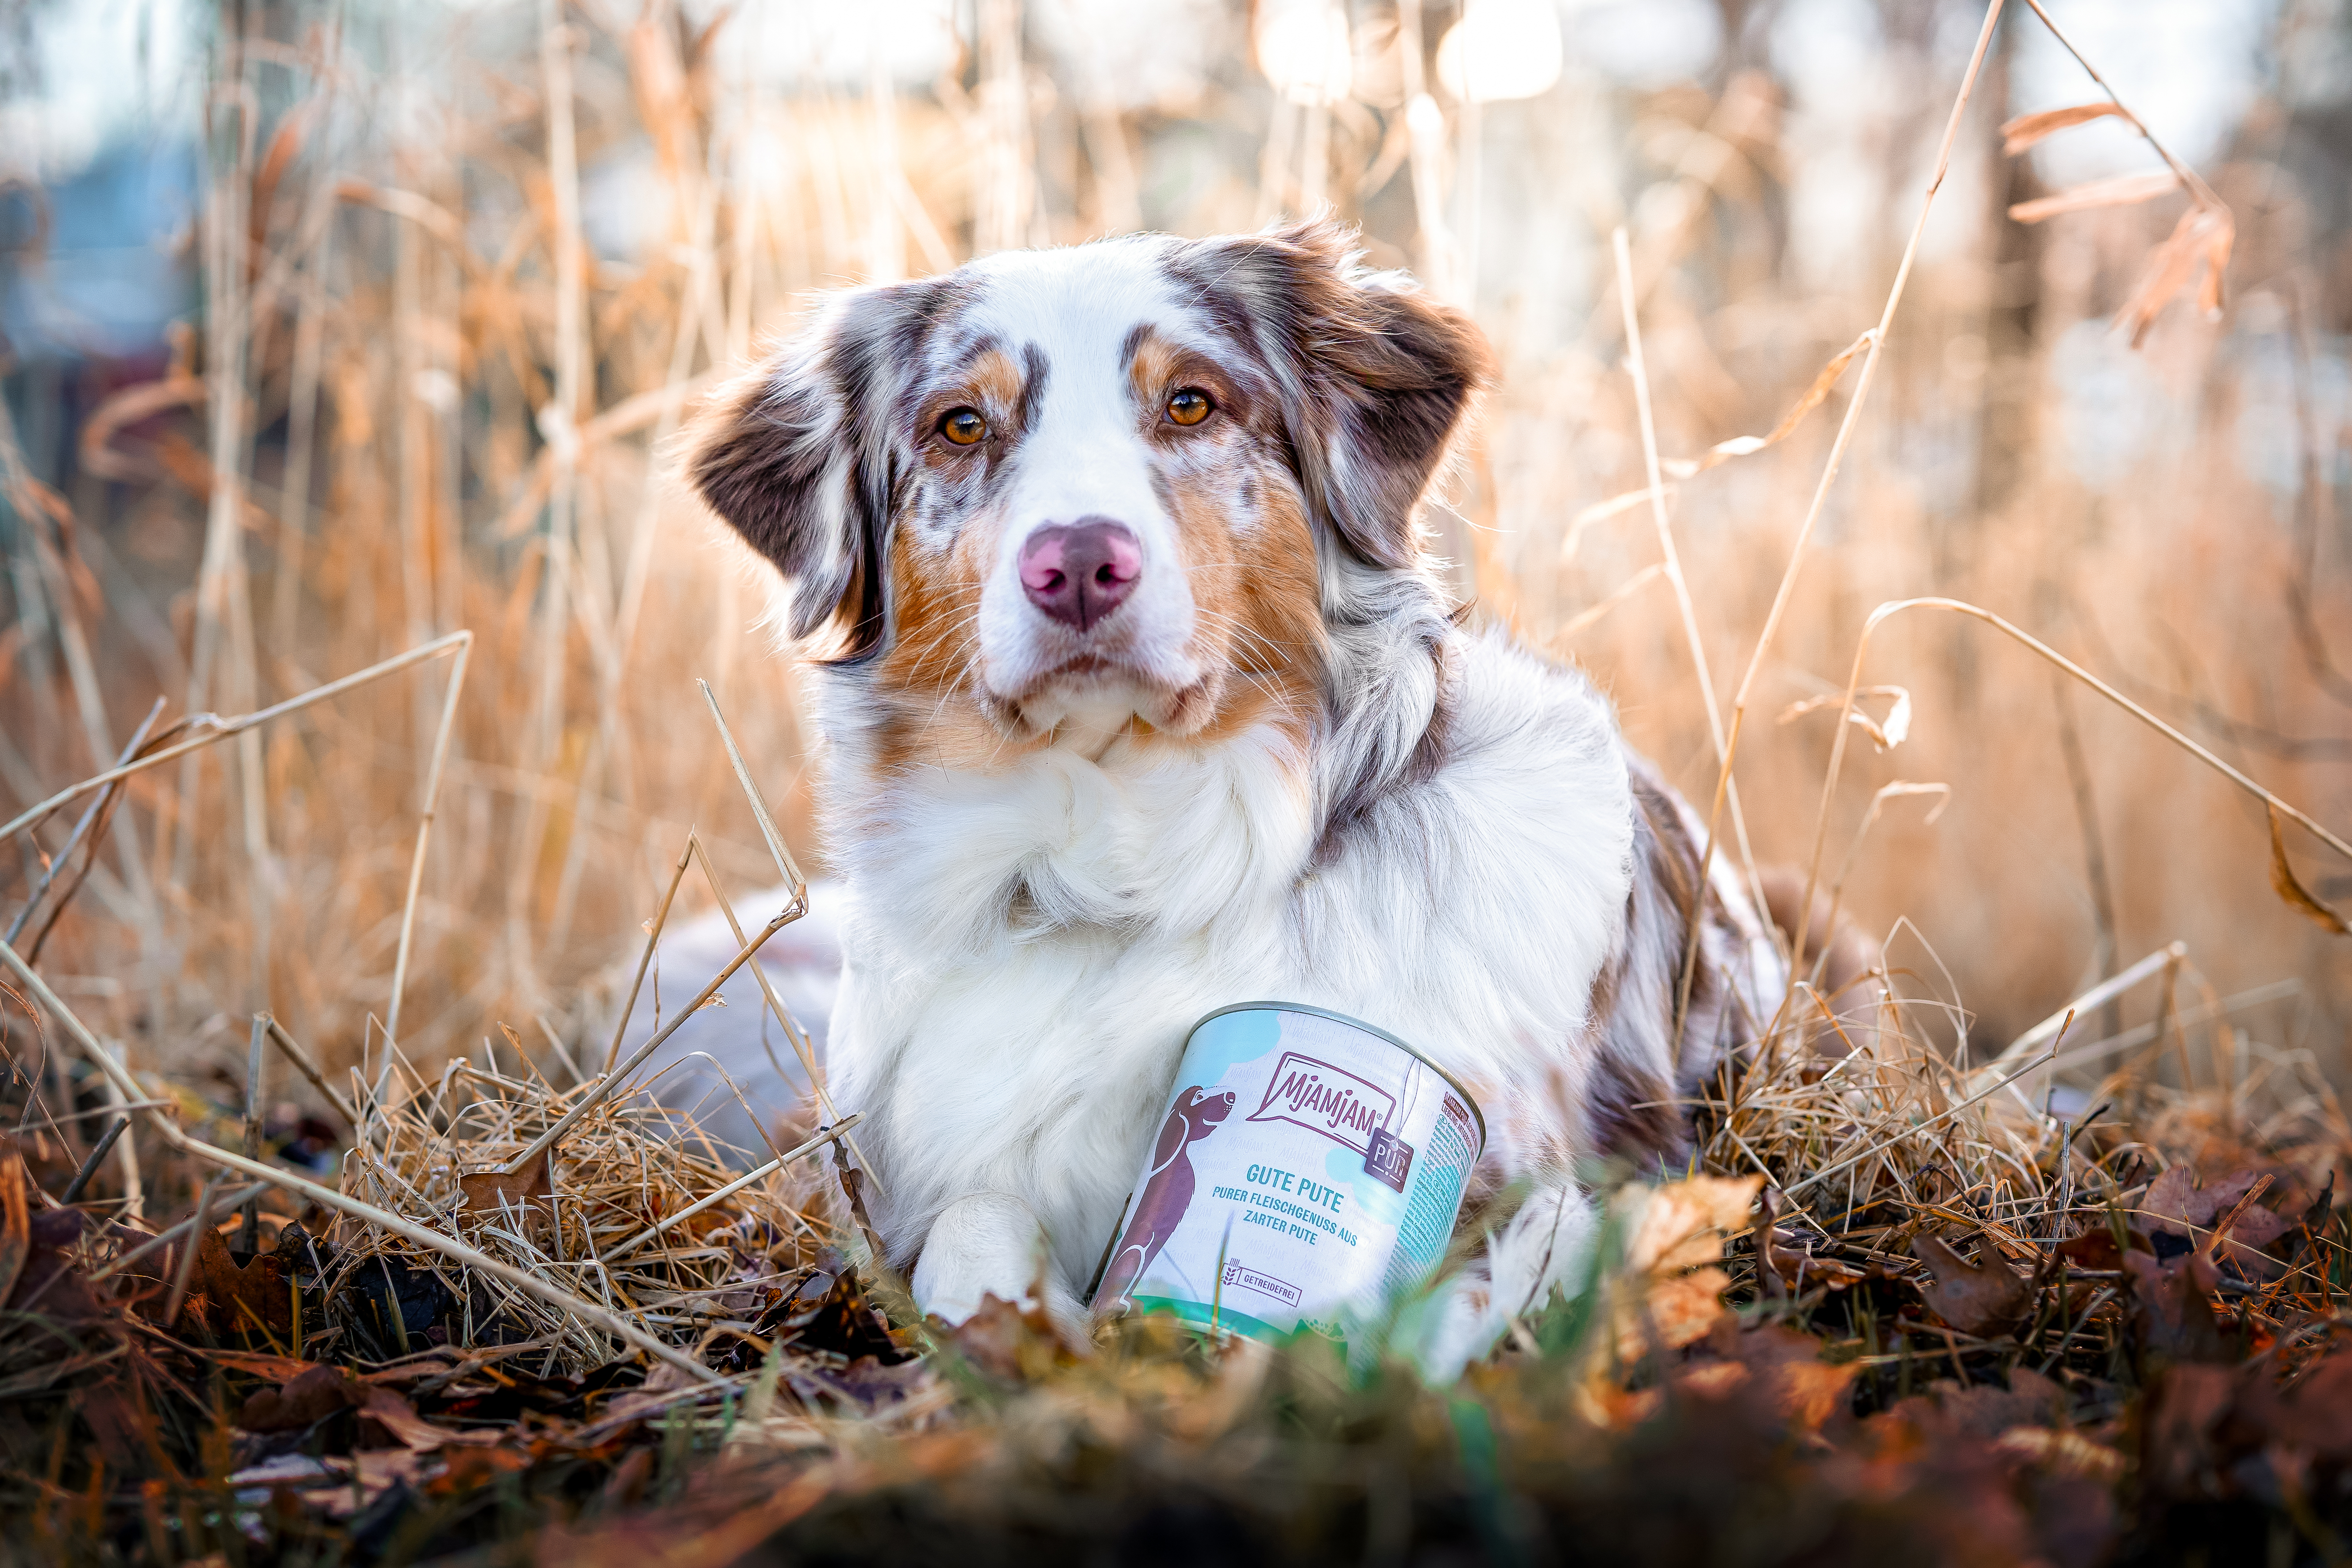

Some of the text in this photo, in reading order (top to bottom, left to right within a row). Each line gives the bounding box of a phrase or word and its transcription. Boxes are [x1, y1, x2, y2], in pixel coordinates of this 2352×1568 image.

[1441, 1104, 1458, 1127] LIEBLING:
[1373, 1143, 1406, 1177] PUR
[1246, 1164, 1345, 1214] GUTE PUTE
[1417, 1177, 1430, 1193] Complete
[1212, 1186, 1358, 1247] PURER FLEISCHGENUSS AUS
[1243, 1210, 1318, 1246] ZARTER PUTE
[1400, 1224, 1411, 1239] Razione
[1244, 1275, 1295, 1300] GETREIDEFREI
